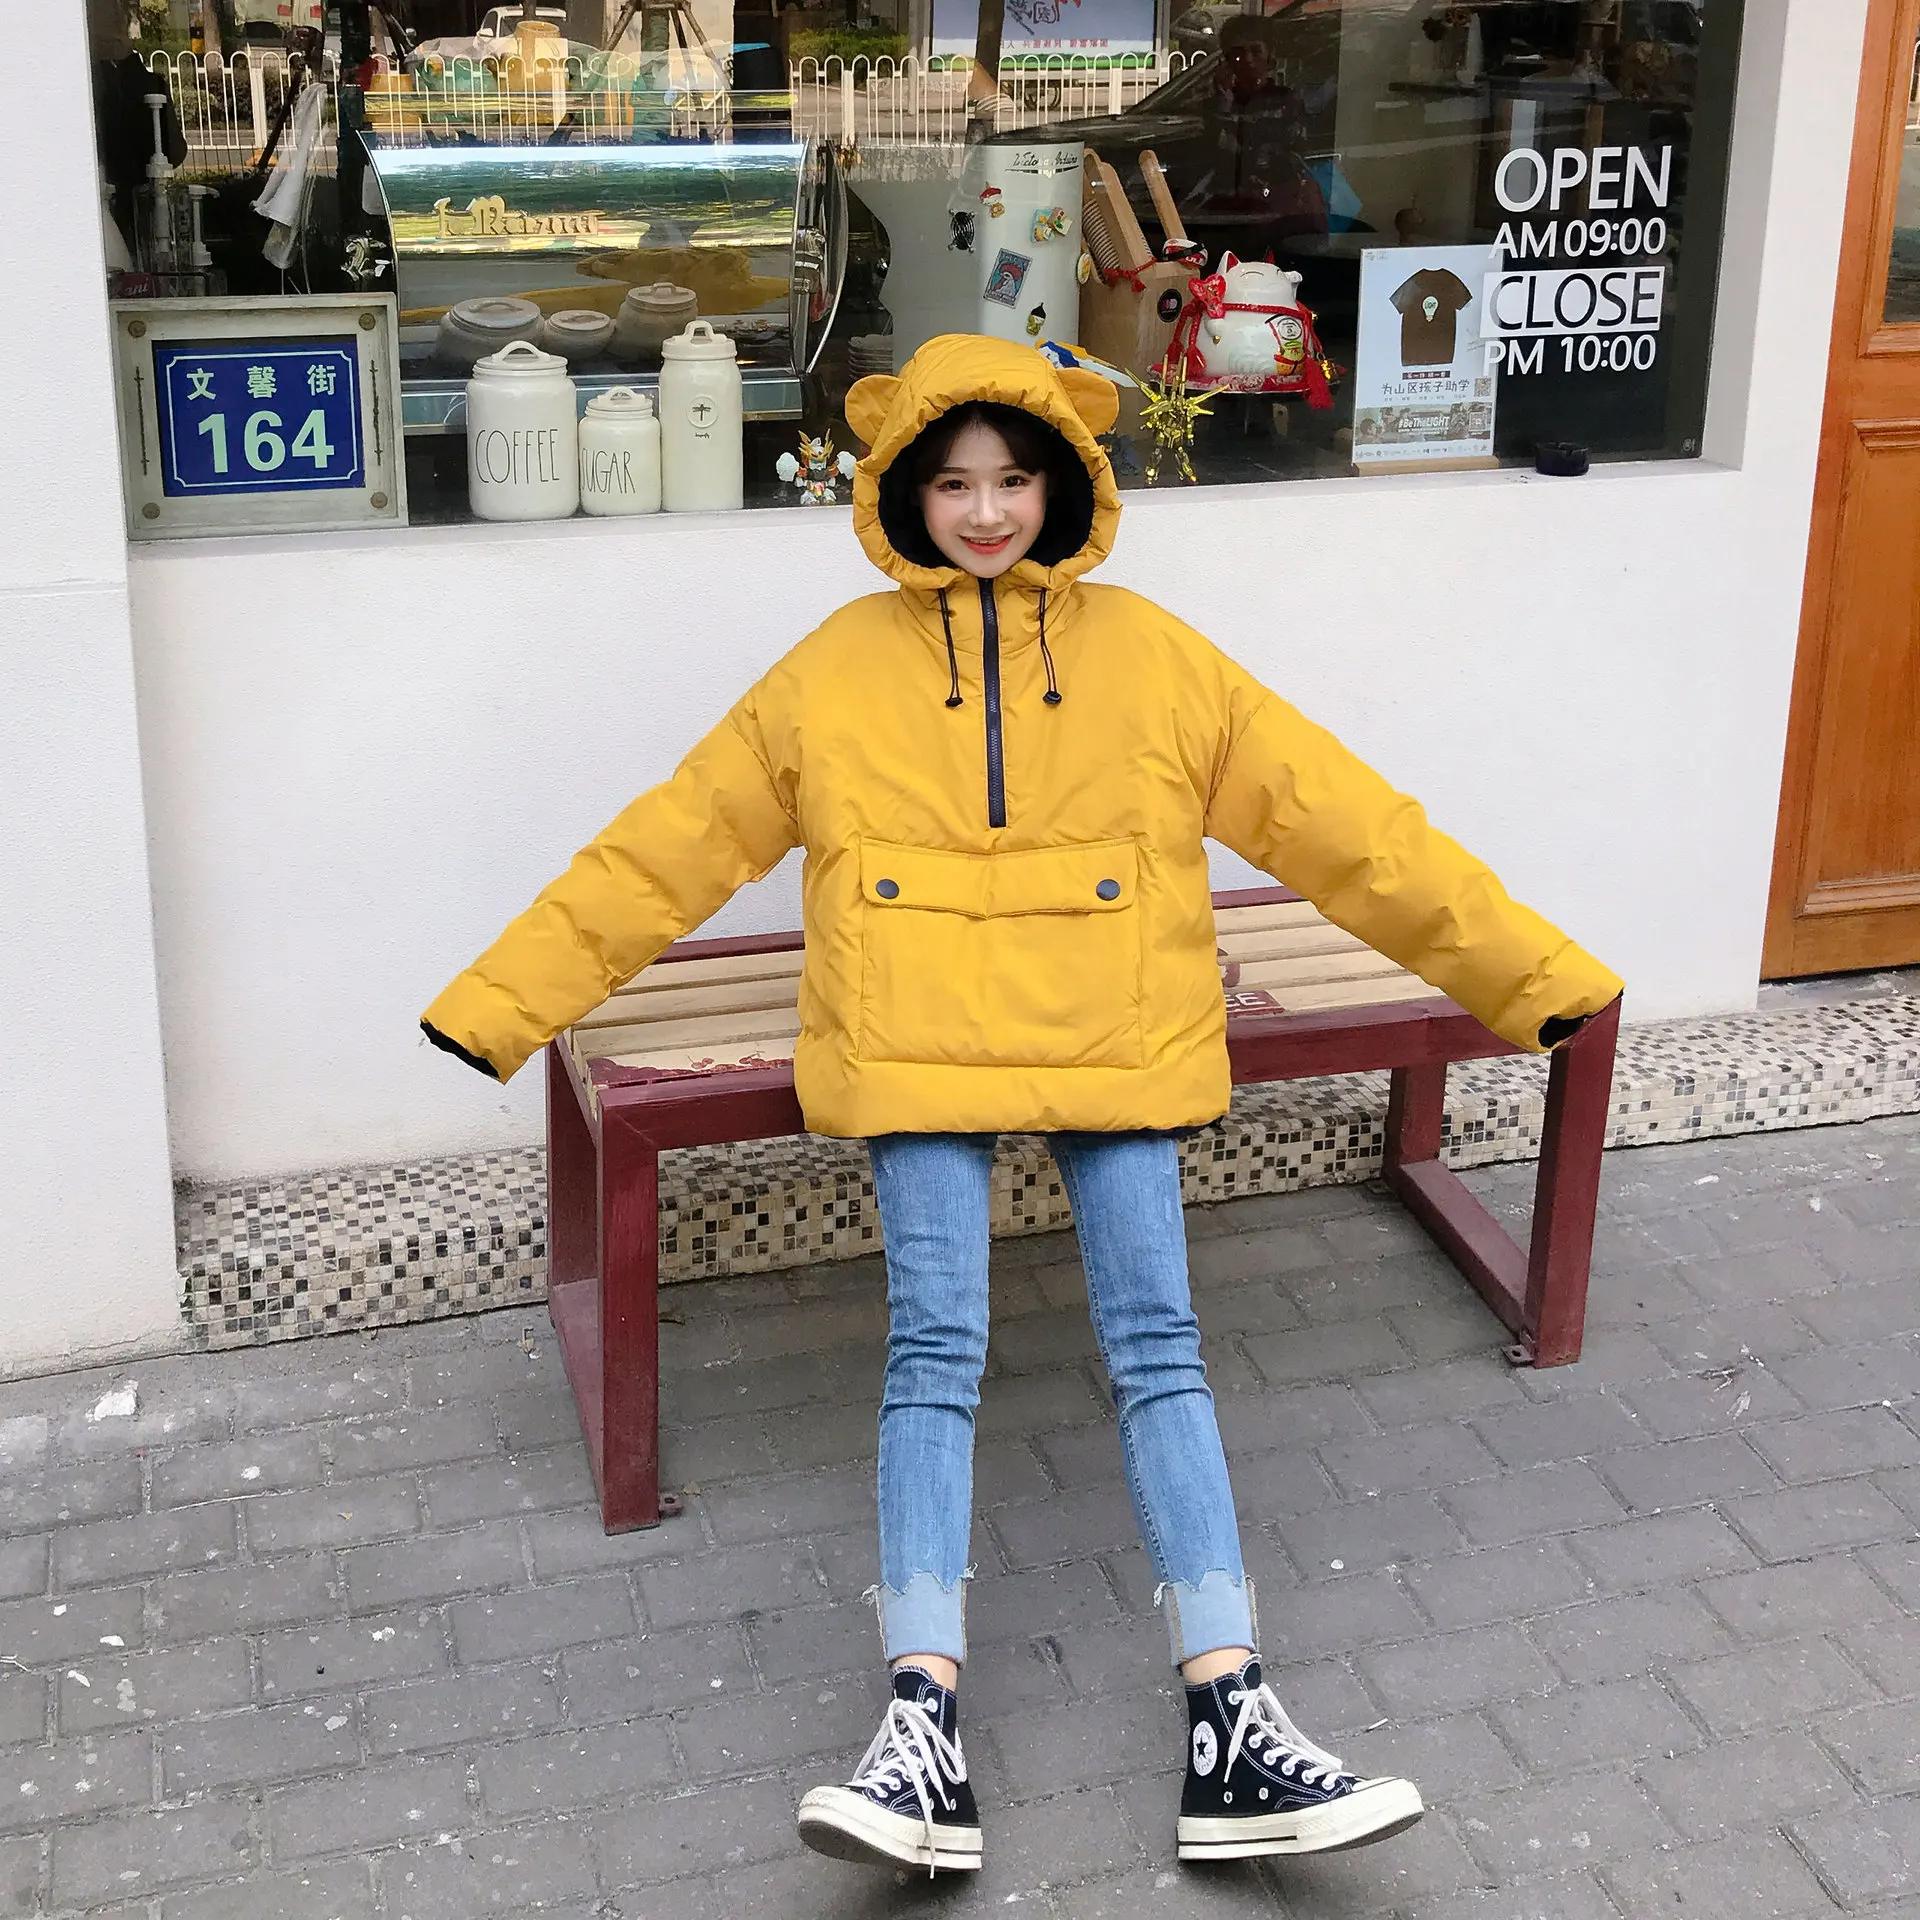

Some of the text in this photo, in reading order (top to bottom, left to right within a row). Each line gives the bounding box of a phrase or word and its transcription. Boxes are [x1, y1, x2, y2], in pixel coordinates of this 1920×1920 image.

[1494, 145, 1672, 212] OPEN
[1488, 217, 1666, 259] AM 09:00
[1489, 271, 1661, 330] CLOSE
[1483, 334, 1656, 376] PM 10:00
[187, 365, 336, 400] 文馨街
[1381, 379, 1470, 395] 为山区孩子助学
[198, 409, 335, 473] 164
[475, 429, 560, 484] COFFEE
